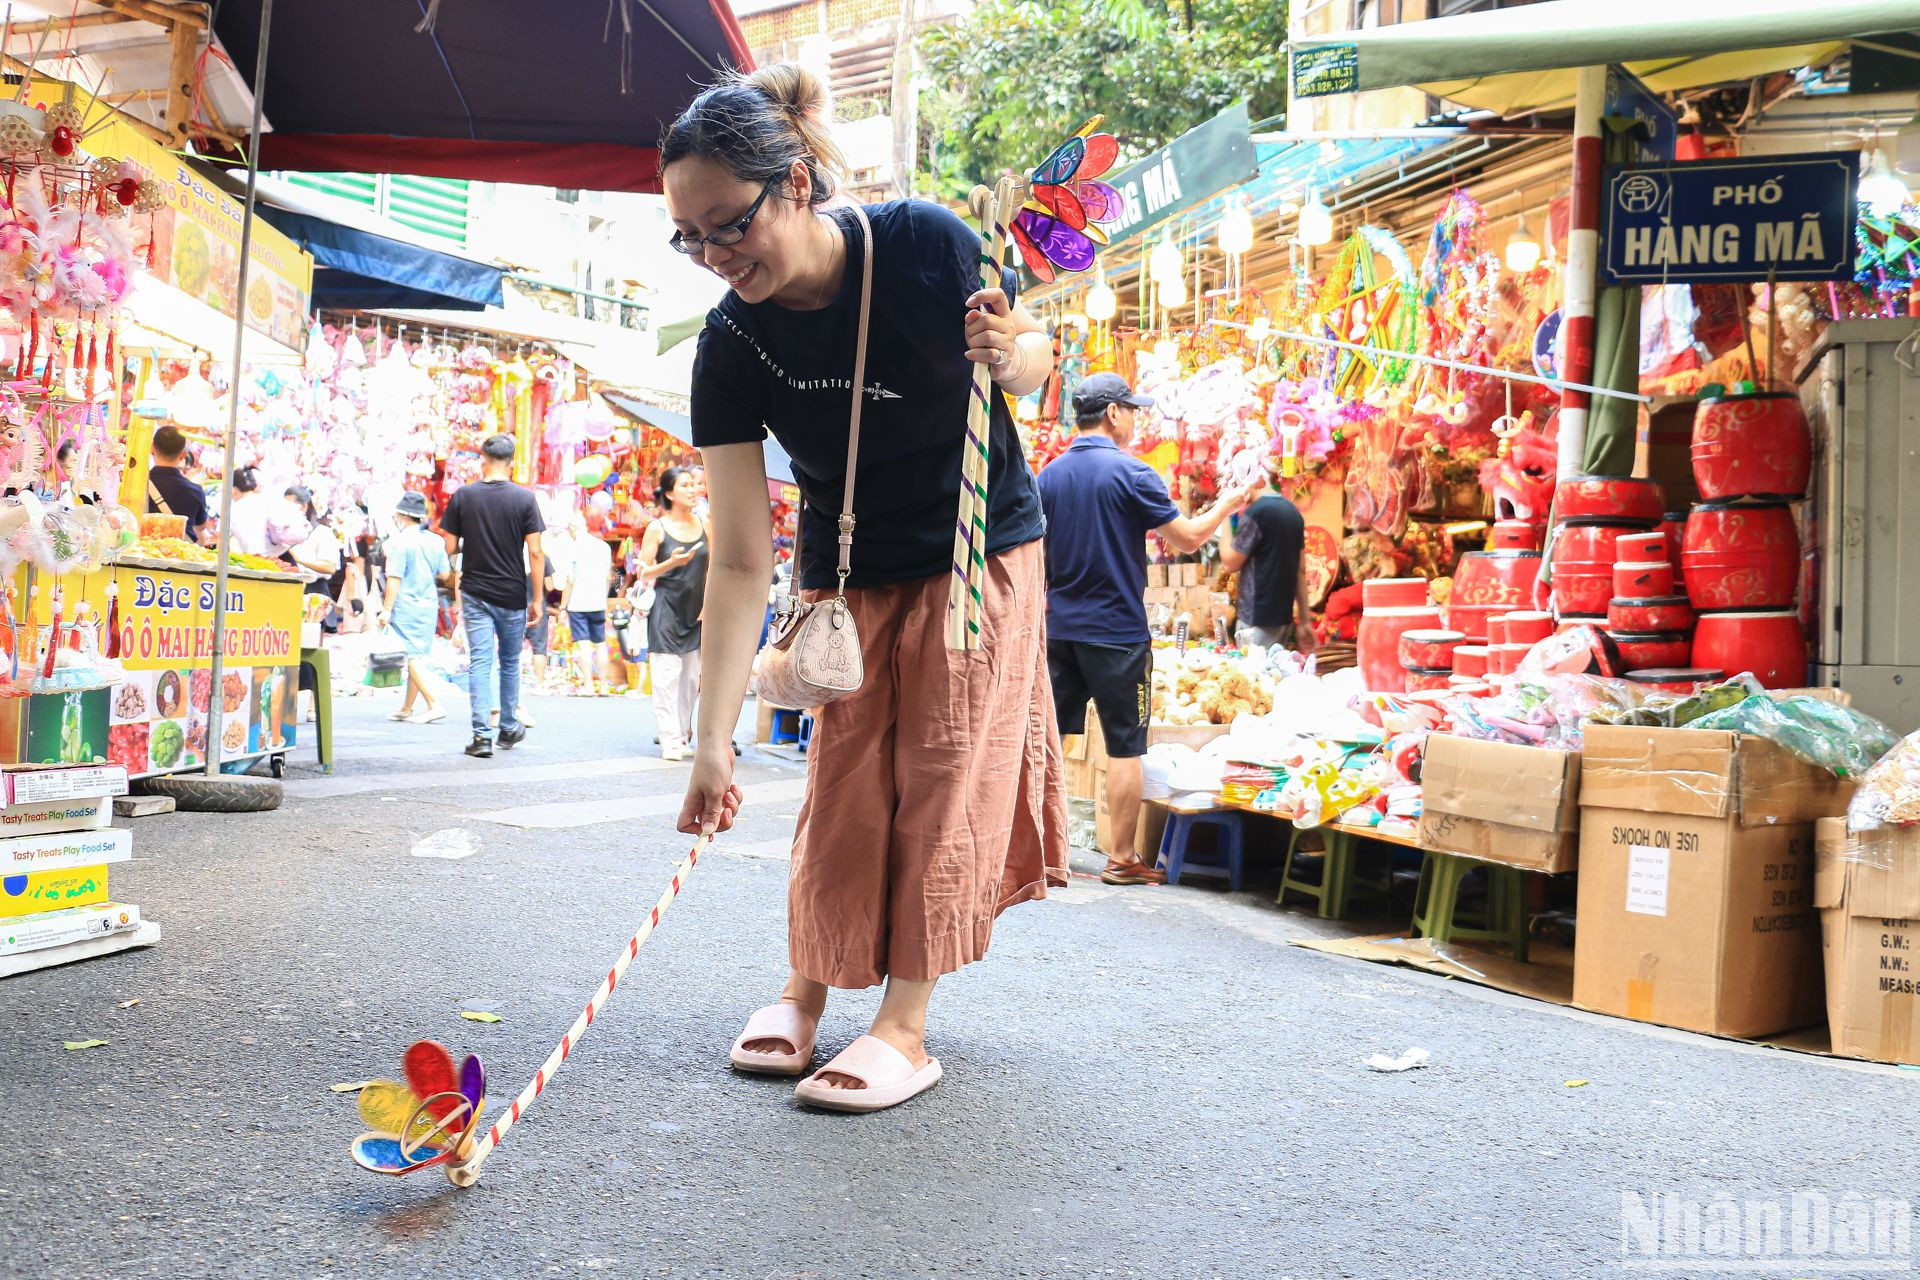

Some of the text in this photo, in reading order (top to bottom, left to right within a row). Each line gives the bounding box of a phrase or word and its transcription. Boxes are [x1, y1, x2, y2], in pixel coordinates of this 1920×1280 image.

[177, 167, 216, 206] Đặc
[220, 198, 243, 224] Sả
[1713, 174, 1785, 206] PHỐ
[179, 190, 189, 209] Ô
[191, 201, 216, 228] MAI
[217, 215, 242, 243] HÀN
[1624, 212, 1825, 266] HÀNG MÃ
[788, 376, 854, 391] LIMITATIO
[134, 576, 244, 614] Đặc Sn
[140, 616, 153, 659] Ô
[157, 627, 191, 658] MAI
[241, 622, 290, 656] ĐƯỜNG
[1, 807, 97, 825] Tasty Treats Play Food Set
[13, 842, 116, 861] Tasty Treats Play Food Set
[1612, 826, 1699, 852] USE NO HOOKS
[1881, 934, 1909, 949] G.W.:
[1880, 956, 1908, 971] N.W.:
